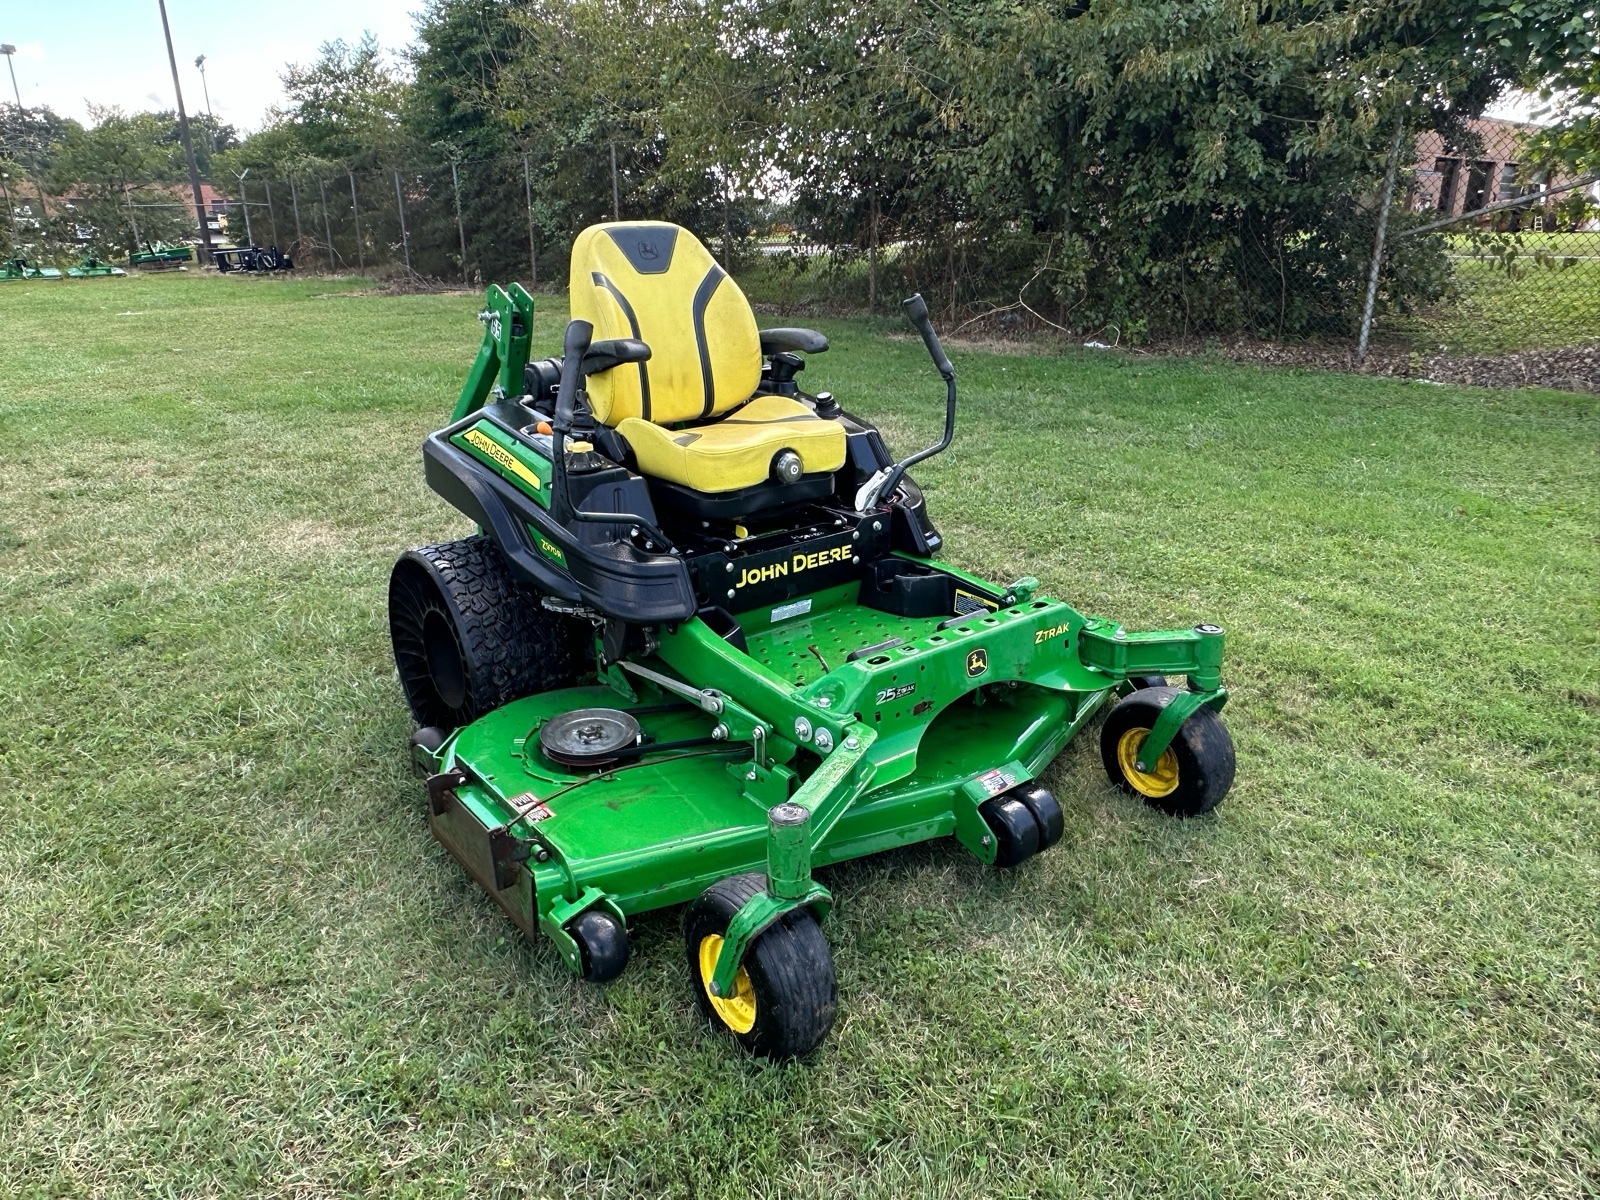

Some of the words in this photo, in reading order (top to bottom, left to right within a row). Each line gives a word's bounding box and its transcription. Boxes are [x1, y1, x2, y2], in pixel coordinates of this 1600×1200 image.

[470, 432, 489, 453] JOHN
[490, 445, 514, 469] DEERE
[735, 561, 788, 588] JOHN
[793, 544, 853, 573] DEERE
[1035, 622, 1069, 644] ZTRAK
[876, 687, 896, 706] 25
